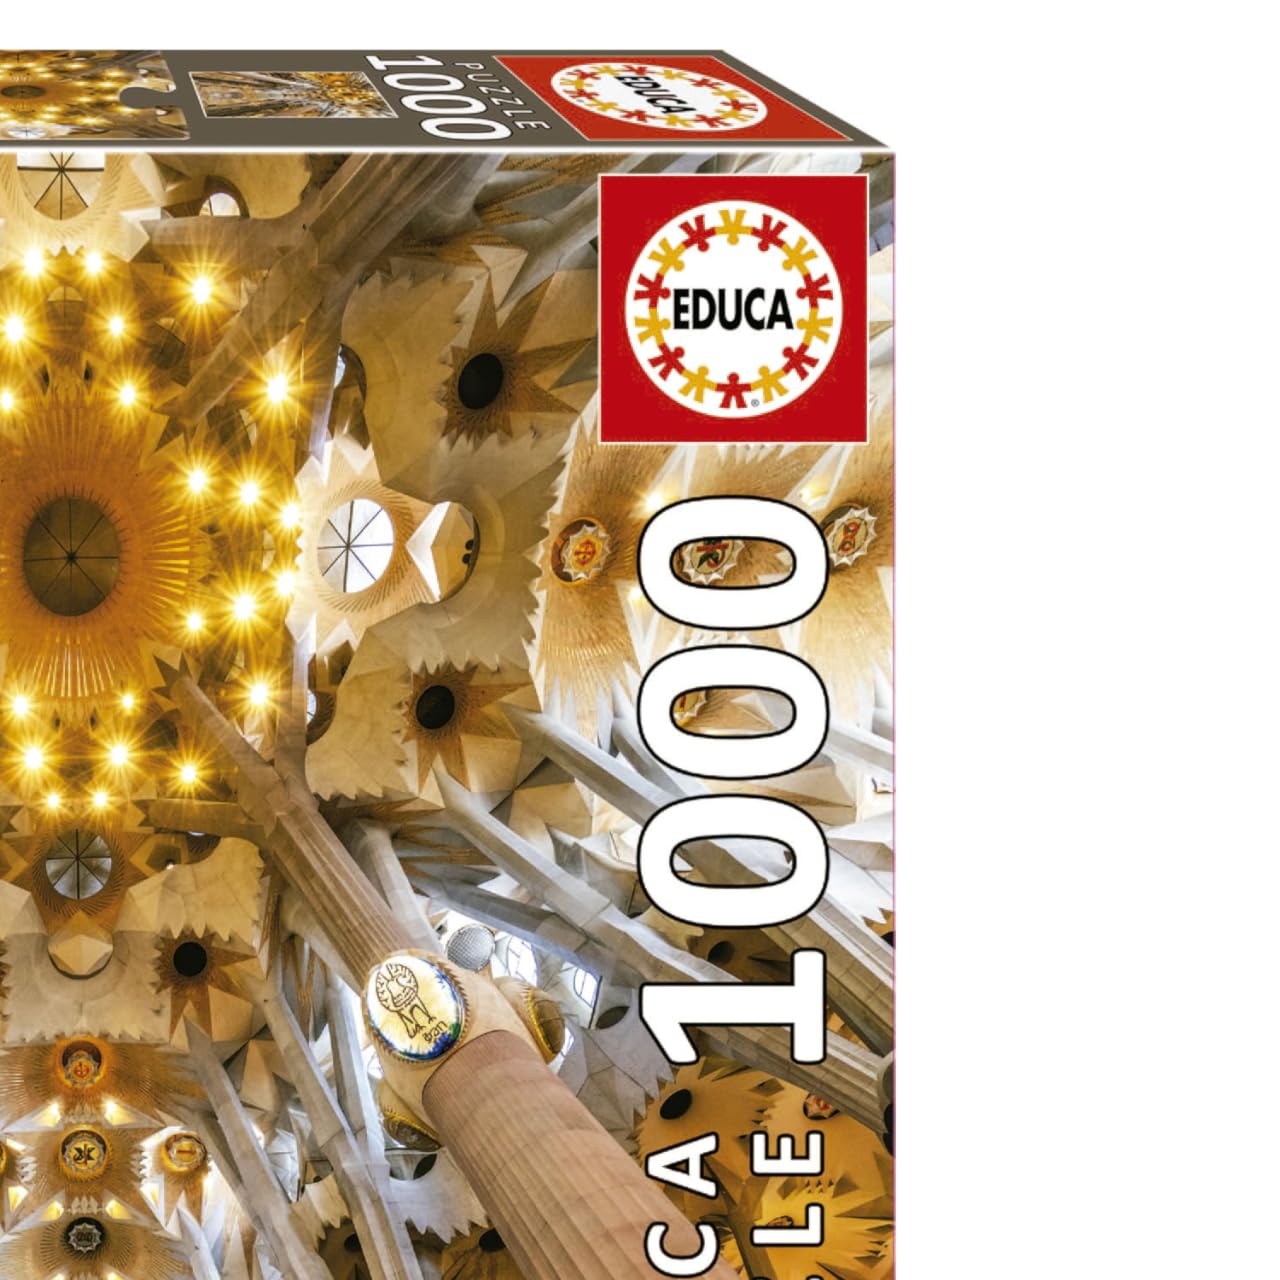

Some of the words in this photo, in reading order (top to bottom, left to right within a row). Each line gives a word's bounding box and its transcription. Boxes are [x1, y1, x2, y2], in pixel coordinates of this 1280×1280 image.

[364, 54, 513, 140] 1000
[453, 61, 552, 131] PUZZLE
[614, 75, 696, 114] EDUCA
[673, 287, 794, 331] EDUCA
[638, 494, 830, 1066] 1000
